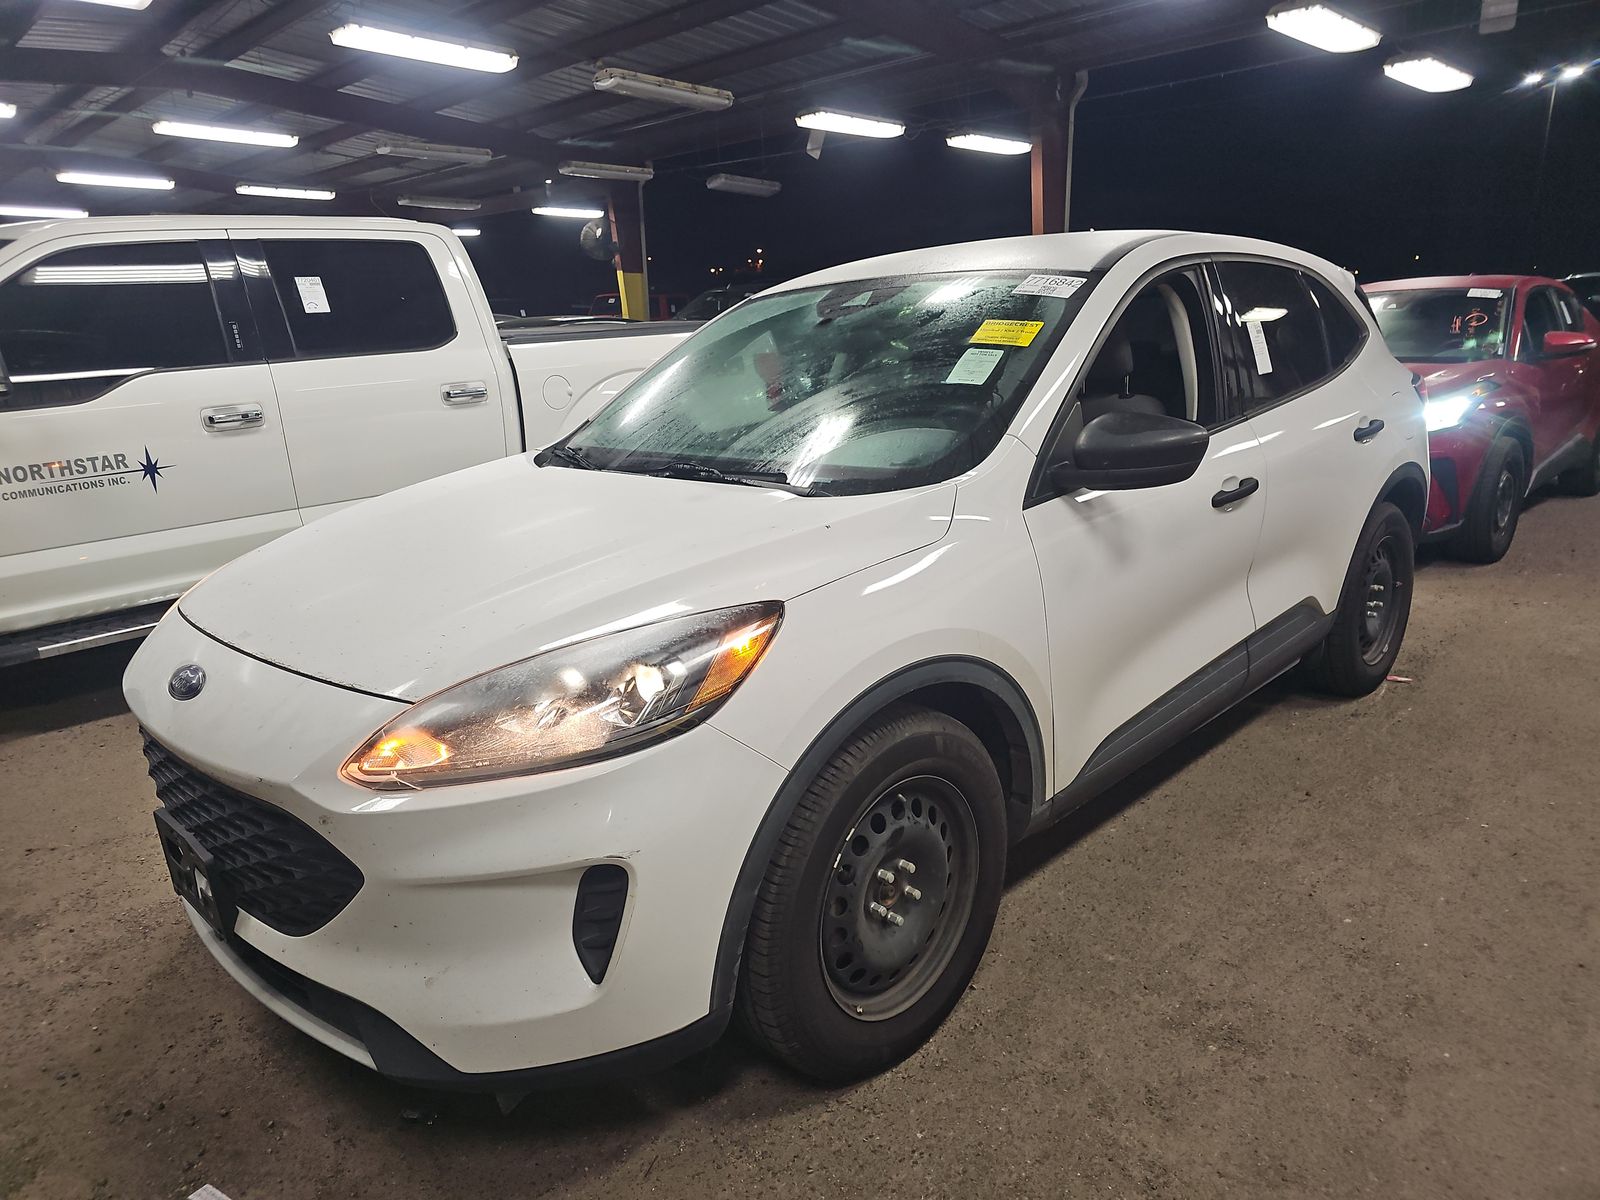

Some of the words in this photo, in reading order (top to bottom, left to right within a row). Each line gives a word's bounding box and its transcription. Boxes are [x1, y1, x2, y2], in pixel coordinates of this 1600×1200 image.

[1026, 276, 1083, 288] 7716842
[0, 453, 129, 486] NORTHSTAR
[2, 480, 105, 501] COMMUNICATIONS
[108, 477, 131, 487] INC.
